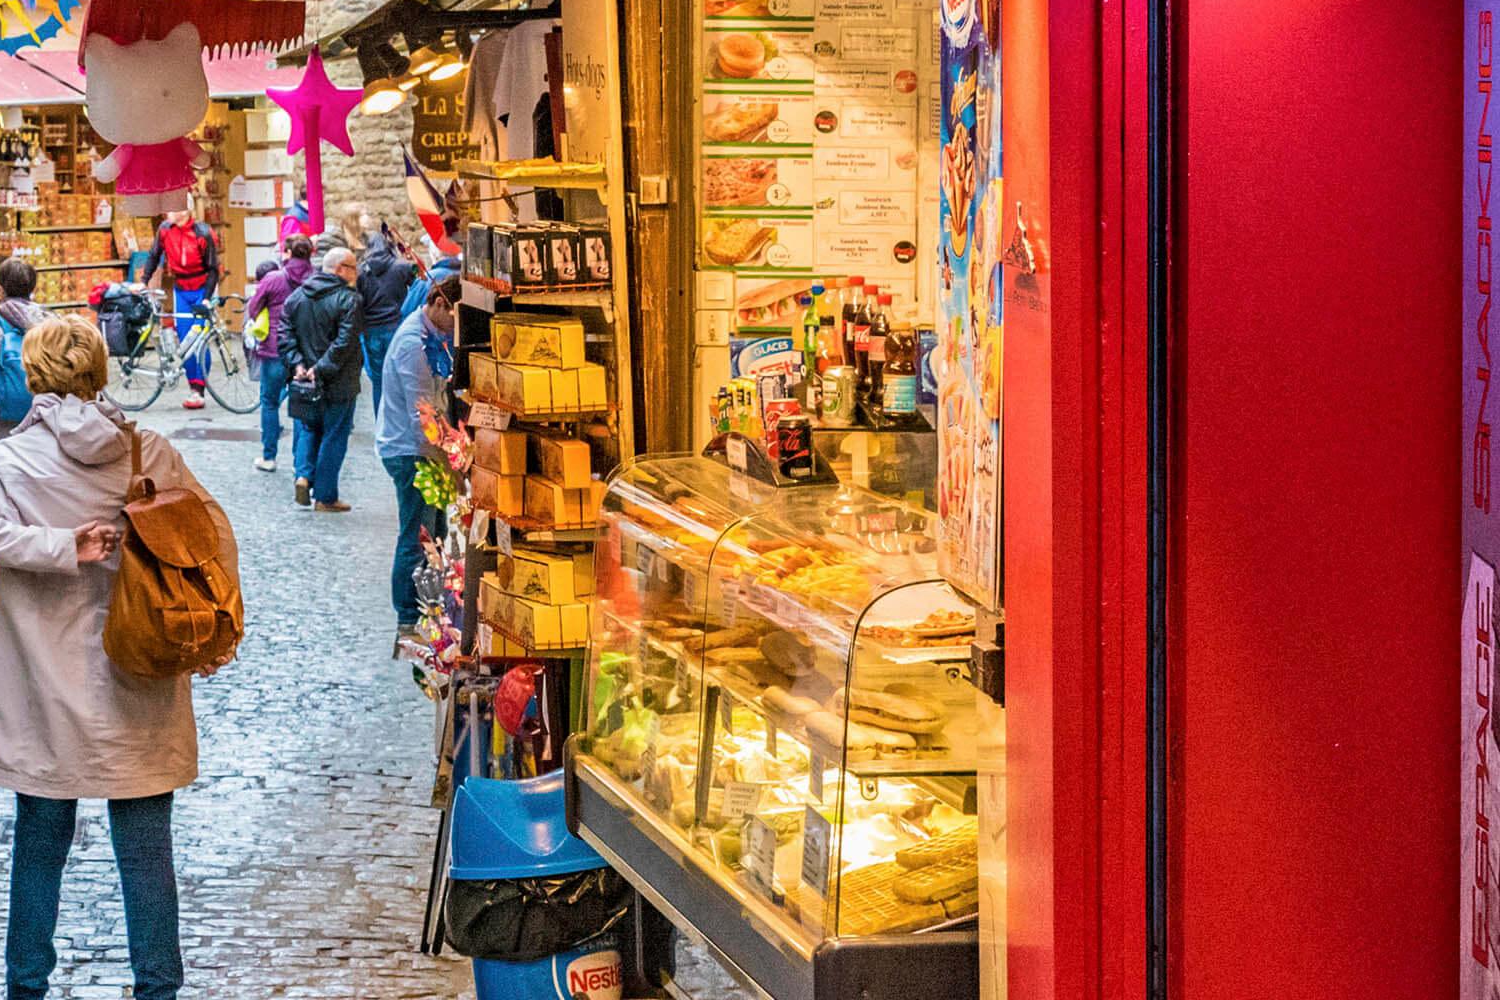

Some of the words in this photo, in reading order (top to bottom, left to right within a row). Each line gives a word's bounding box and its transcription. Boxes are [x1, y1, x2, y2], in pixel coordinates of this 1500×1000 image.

[423, 96, 447, 115] La
[421, 131, 470, 147] CREP
[1474, 9, 1493, 515] SNACKING
[754, 341, 789, 357] GLACES
[1472, 579, 1491, 970] ESPACE
[571, 964, 620, 993] Nestl
